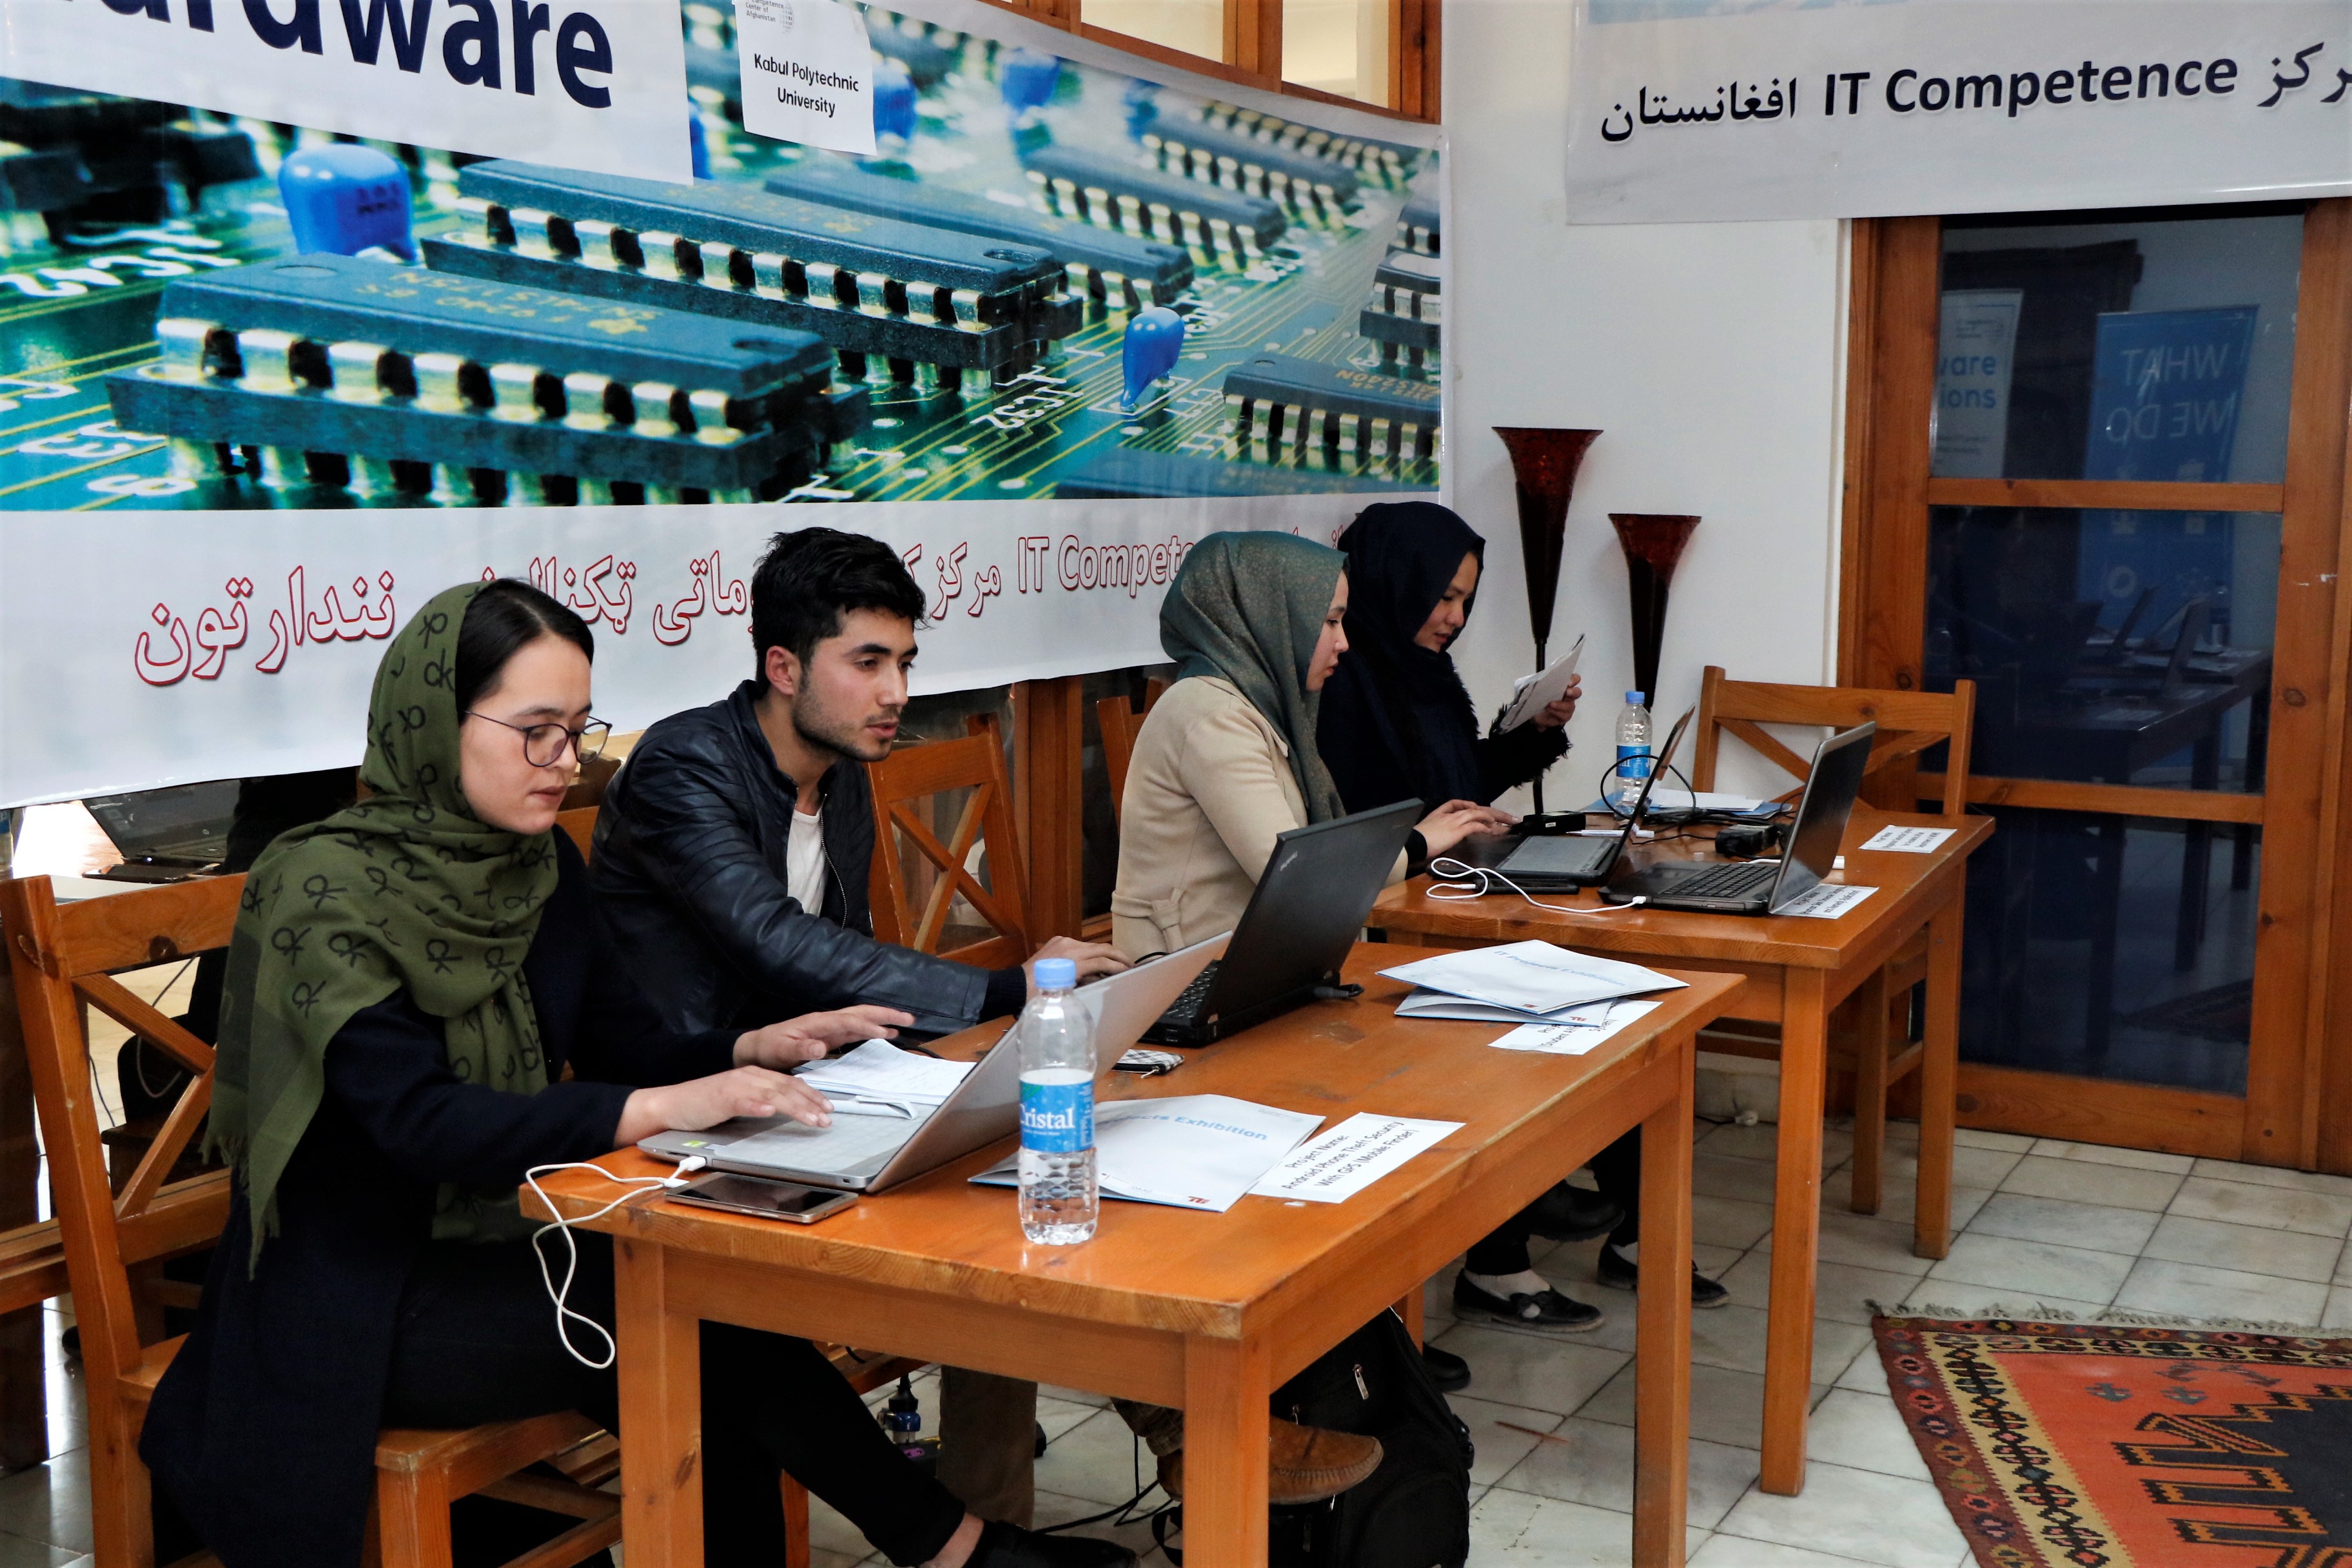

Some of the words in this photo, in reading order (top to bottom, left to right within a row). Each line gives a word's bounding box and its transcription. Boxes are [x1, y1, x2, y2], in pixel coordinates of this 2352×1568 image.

[746, 10, 776, 23] Afghanistan
[754, 53, 789, 76] Kabul
[792, 62, 859, 92] Polytechnic
[1825, 72, 1870, 117] IT
[1885, 50, 2238, 119] Competence
[777, 86, 836, 119] University
[1600, 76, 1798, 142] افغانستان
[930, 541, 1001, 621] مرکز
[1017, 536, 1050, 594] IT
[1173, 1116, 1268, 1141] Exhibition
[1281, 1168, 1323, 1190] Android
[1317, 1153, 1347, 1169] Phone
[1341, 1139, 1372, 1153] Theft
[1364, 1121, 1405, 1139] Security
[1284, 1150, 1321, 1168] Project
[1315, 1135, 1350, 1151] Name:
[1313, 1173, 1343, 1186] With
[1337, 1162, 1361, 1173] GPS
[1352, 1145, 1391, 1163] (Mobile
[1383, 1129, 1420, 1146] Finder)
